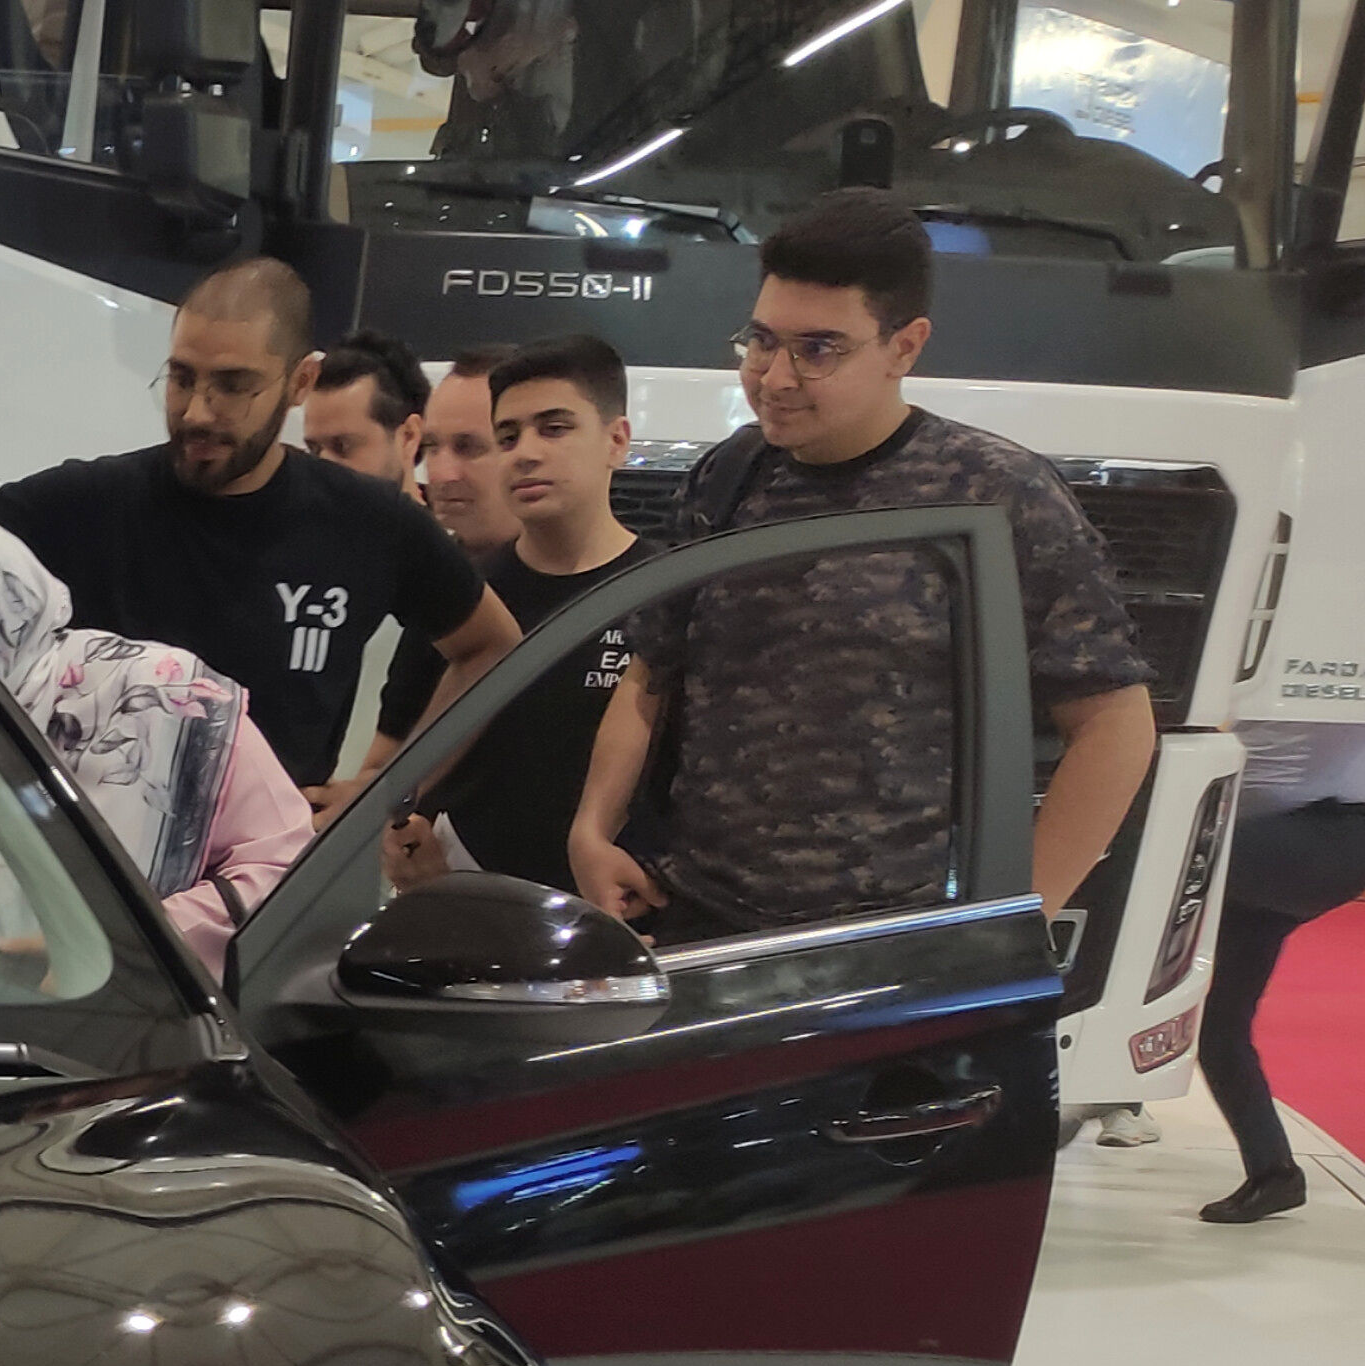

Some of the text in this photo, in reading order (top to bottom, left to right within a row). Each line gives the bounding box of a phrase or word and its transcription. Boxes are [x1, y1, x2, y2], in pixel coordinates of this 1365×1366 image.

[275, 582, 349, 628] Y-3
[599, 651, 631, 670] EA
[1284, 658, 1365, 677] FARD
